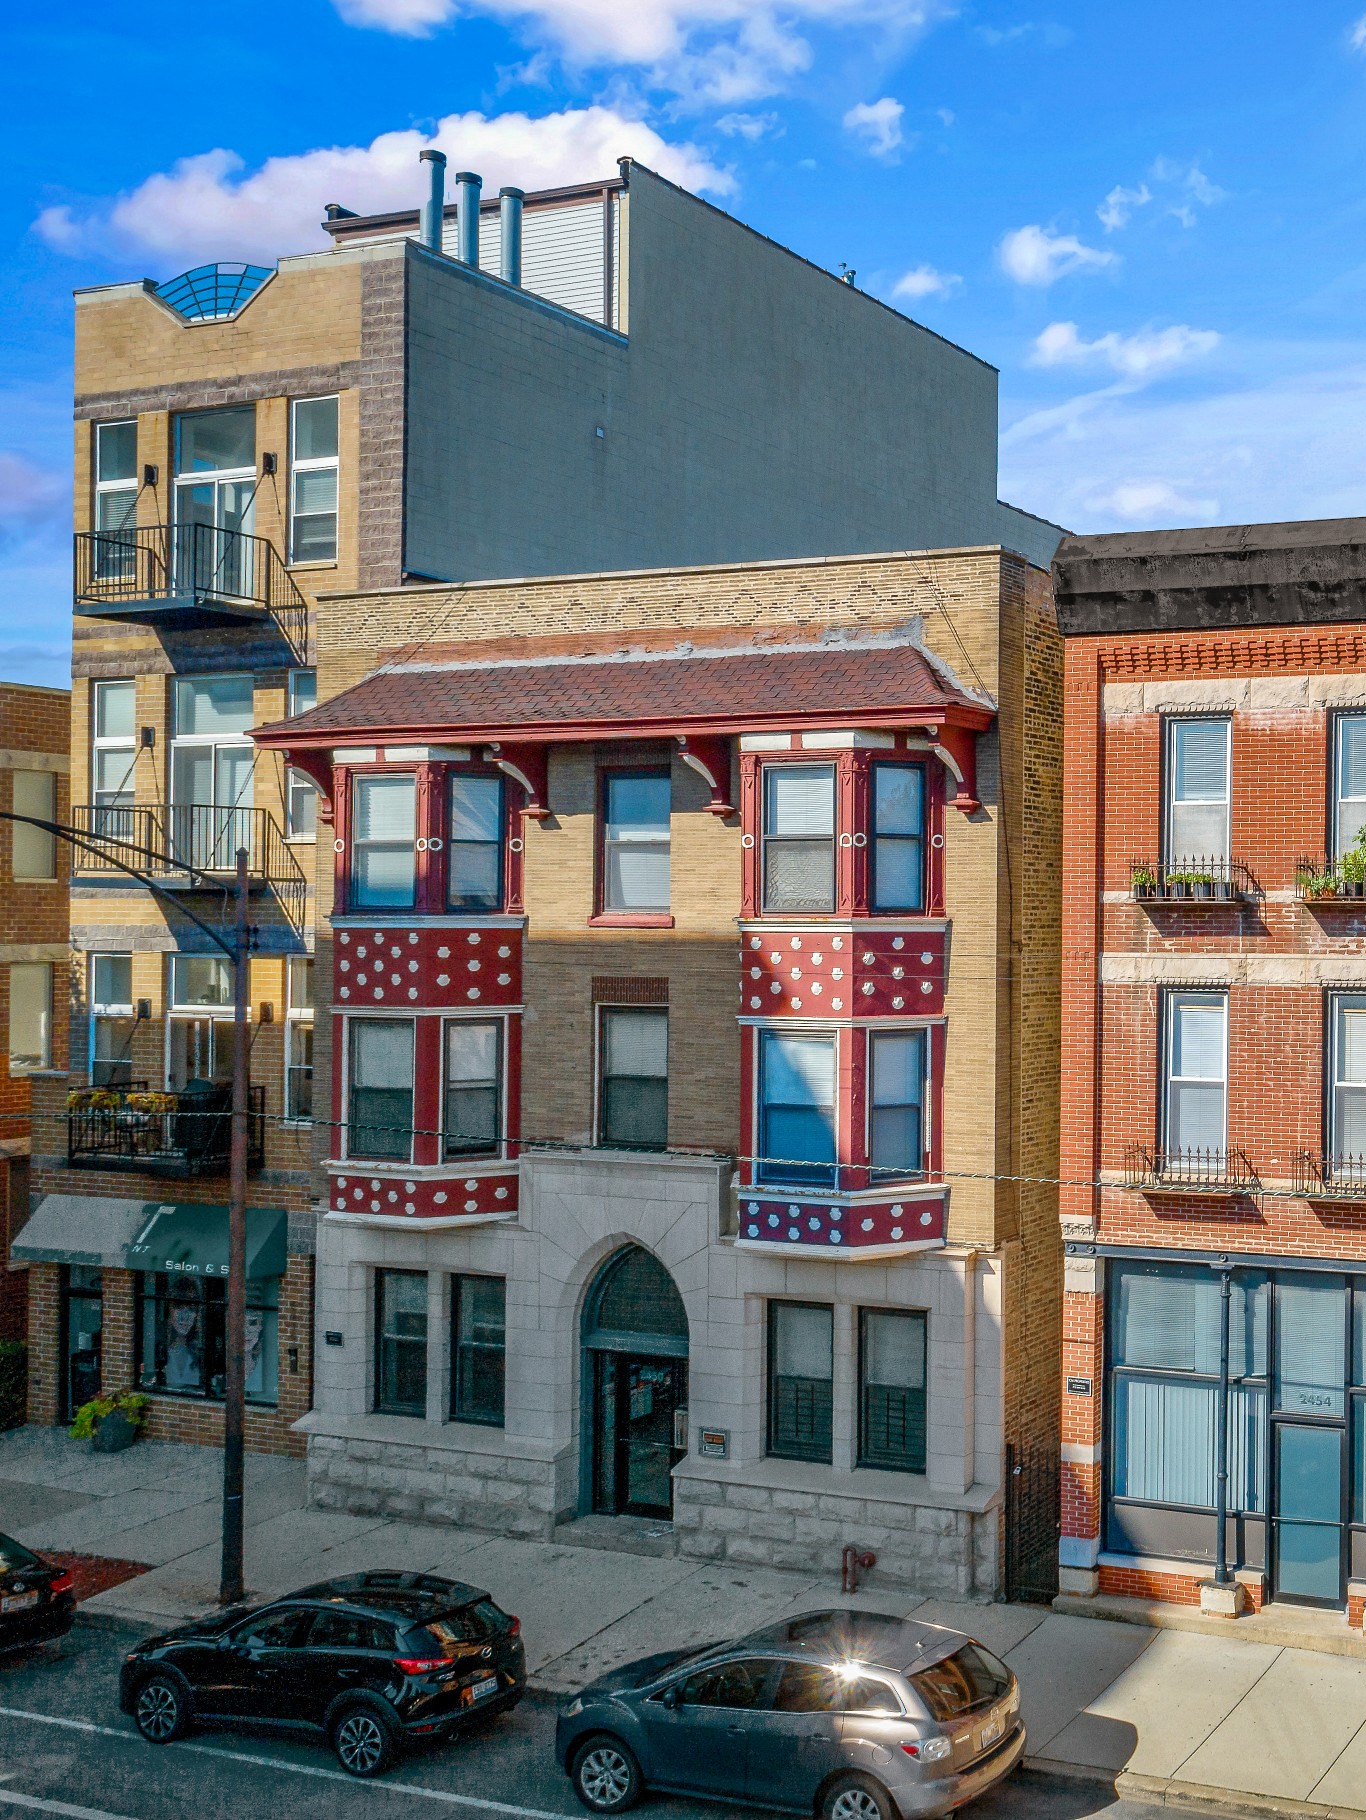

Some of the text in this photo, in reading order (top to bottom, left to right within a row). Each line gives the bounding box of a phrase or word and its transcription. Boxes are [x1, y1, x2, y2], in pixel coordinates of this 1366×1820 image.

[165, 1259, 200, 1272] Salon
[205, 1263, 215, 1273] &
[1300, 1393, 1332, 1407] 2454
